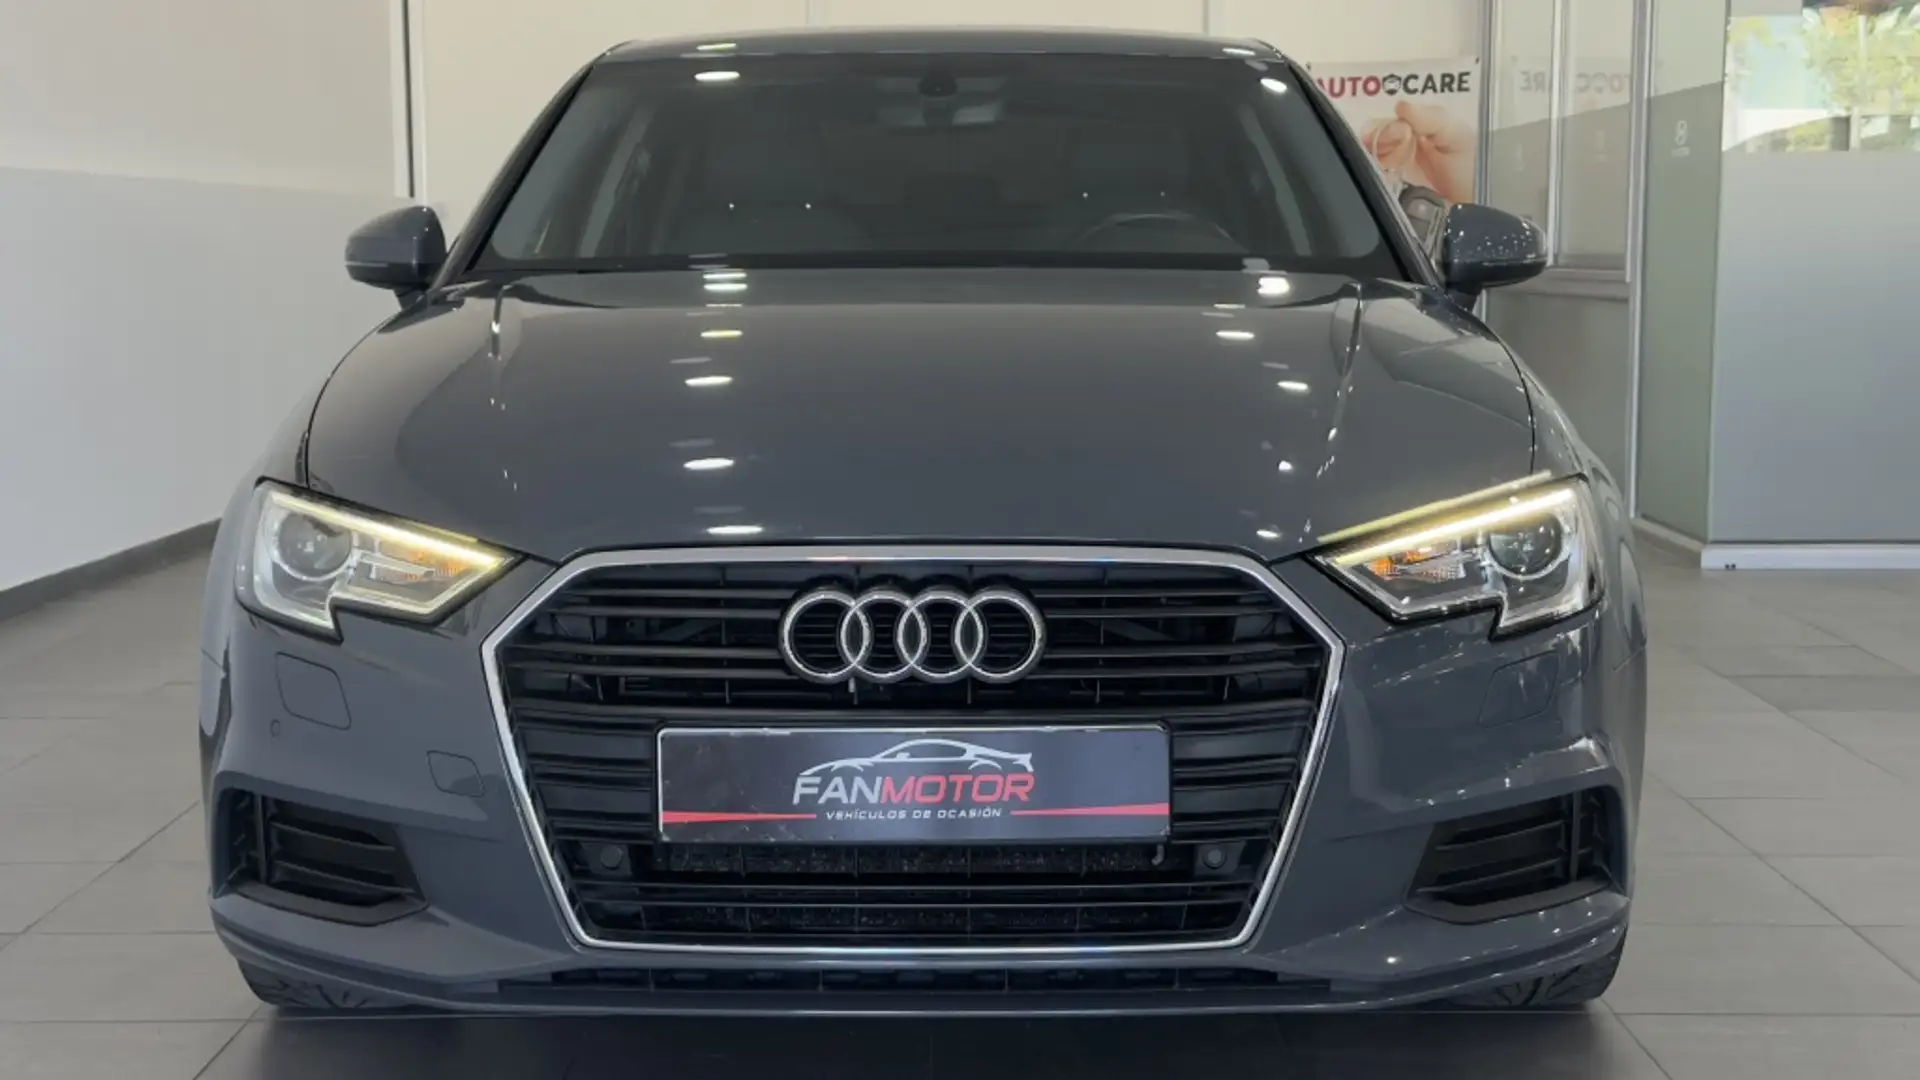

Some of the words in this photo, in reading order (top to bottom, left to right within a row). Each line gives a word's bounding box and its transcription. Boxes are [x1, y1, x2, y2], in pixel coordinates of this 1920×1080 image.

[1402, 72, 1470, 95] CARE
[793, 774, 1035, 805] FANMOTOR
[826, 808, 907, 820] VEHÍCULOS
[912, 810, 931, 819] DE
[937, 806, 1002, 819] OCASIÓN
